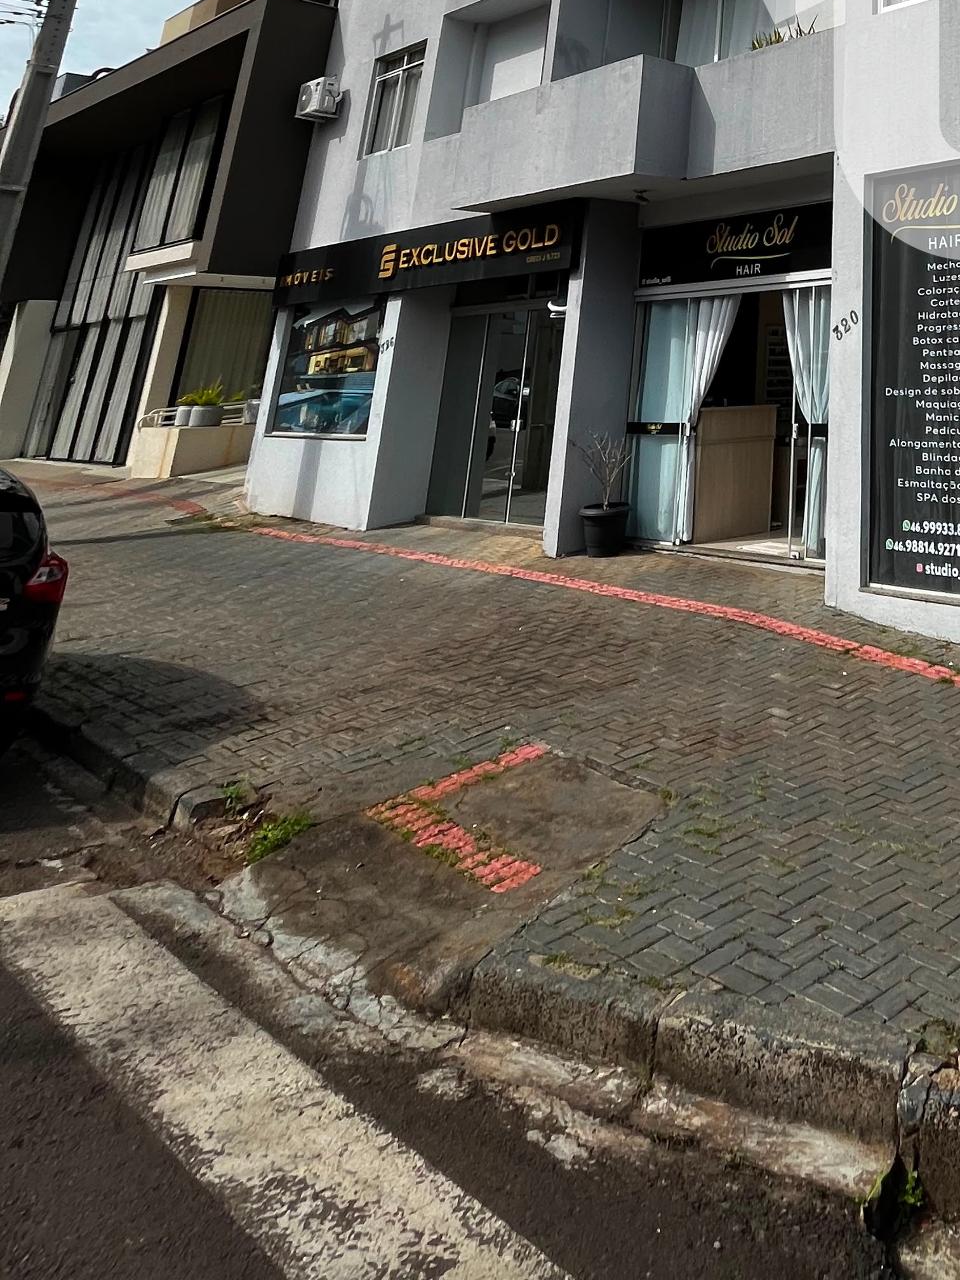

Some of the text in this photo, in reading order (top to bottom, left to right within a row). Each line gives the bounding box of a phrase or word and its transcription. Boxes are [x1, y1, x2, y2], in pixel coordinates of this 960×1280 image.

[882, 183, 958, 223] Studio
[706, 213, 799, 254] Studio Sol
[399, 223, 560, 269] EXCLUSIVE GOLD
[735, 263, 761, 276] HAIR
[832, 309, 859, 341] 320
[912, 336, 943, 345] Botox
[885, 387, 922, 397] Design
[924, 387, 938, 395] de
[915, 466, 951, 476] Banho
[916, 493, 938, 502] SPA
